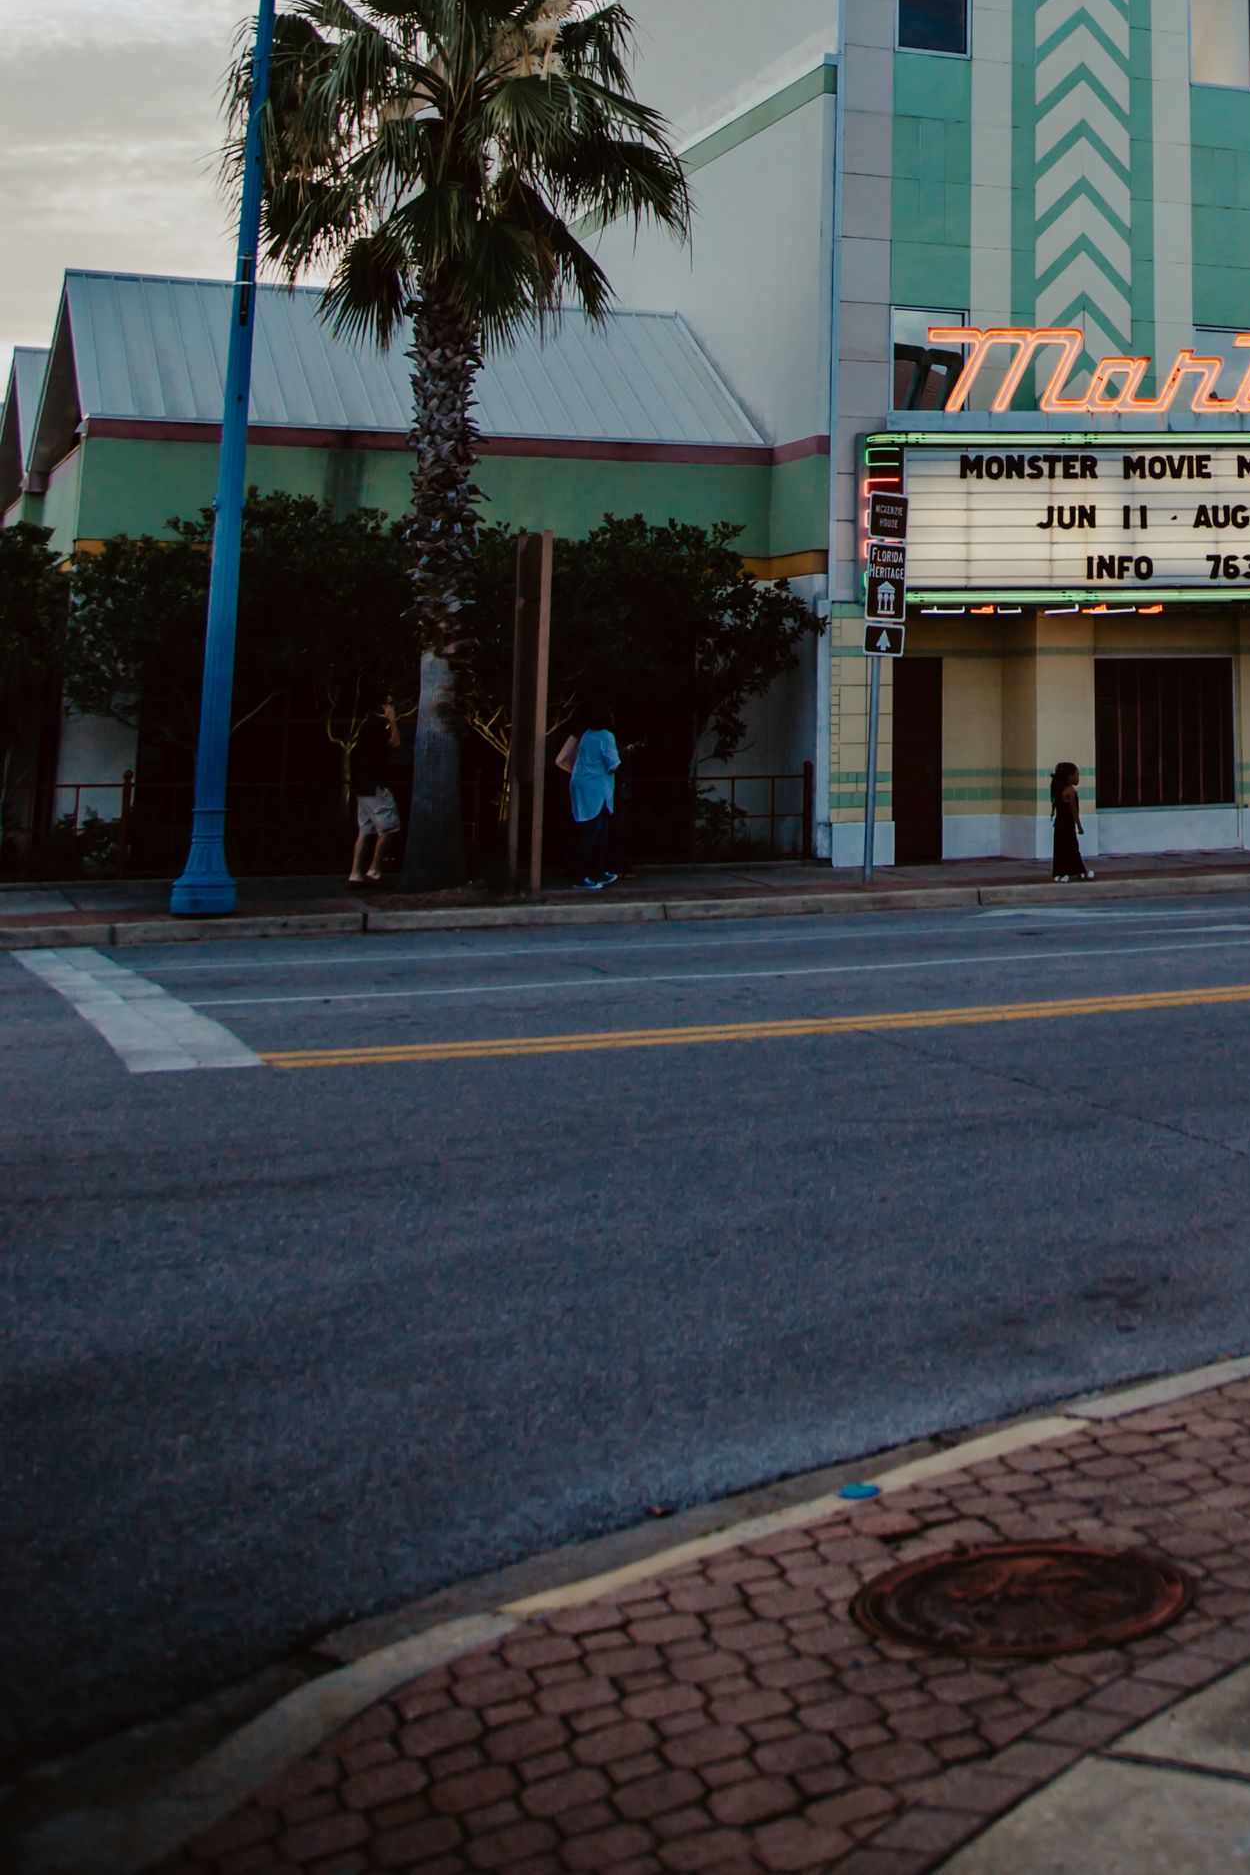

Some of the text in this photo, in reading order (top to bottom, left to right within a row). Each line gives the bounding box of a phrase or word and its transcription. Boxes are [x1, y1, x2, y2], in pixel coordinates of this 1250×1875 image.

[959, 455, 1098, 480] MONSTER
[1123, 455, 1212, 479] MOVIE
[1036, 505, 1096, 529] JUN
[1122, 505, 1148, 529] 11
[1193, 504, 1250, 529] AUG
[871, 547, 903, 564] FLORIDA
[1086, 555, 1153, 580] INFO
[869, 563, 905, 580] HERITAGE
